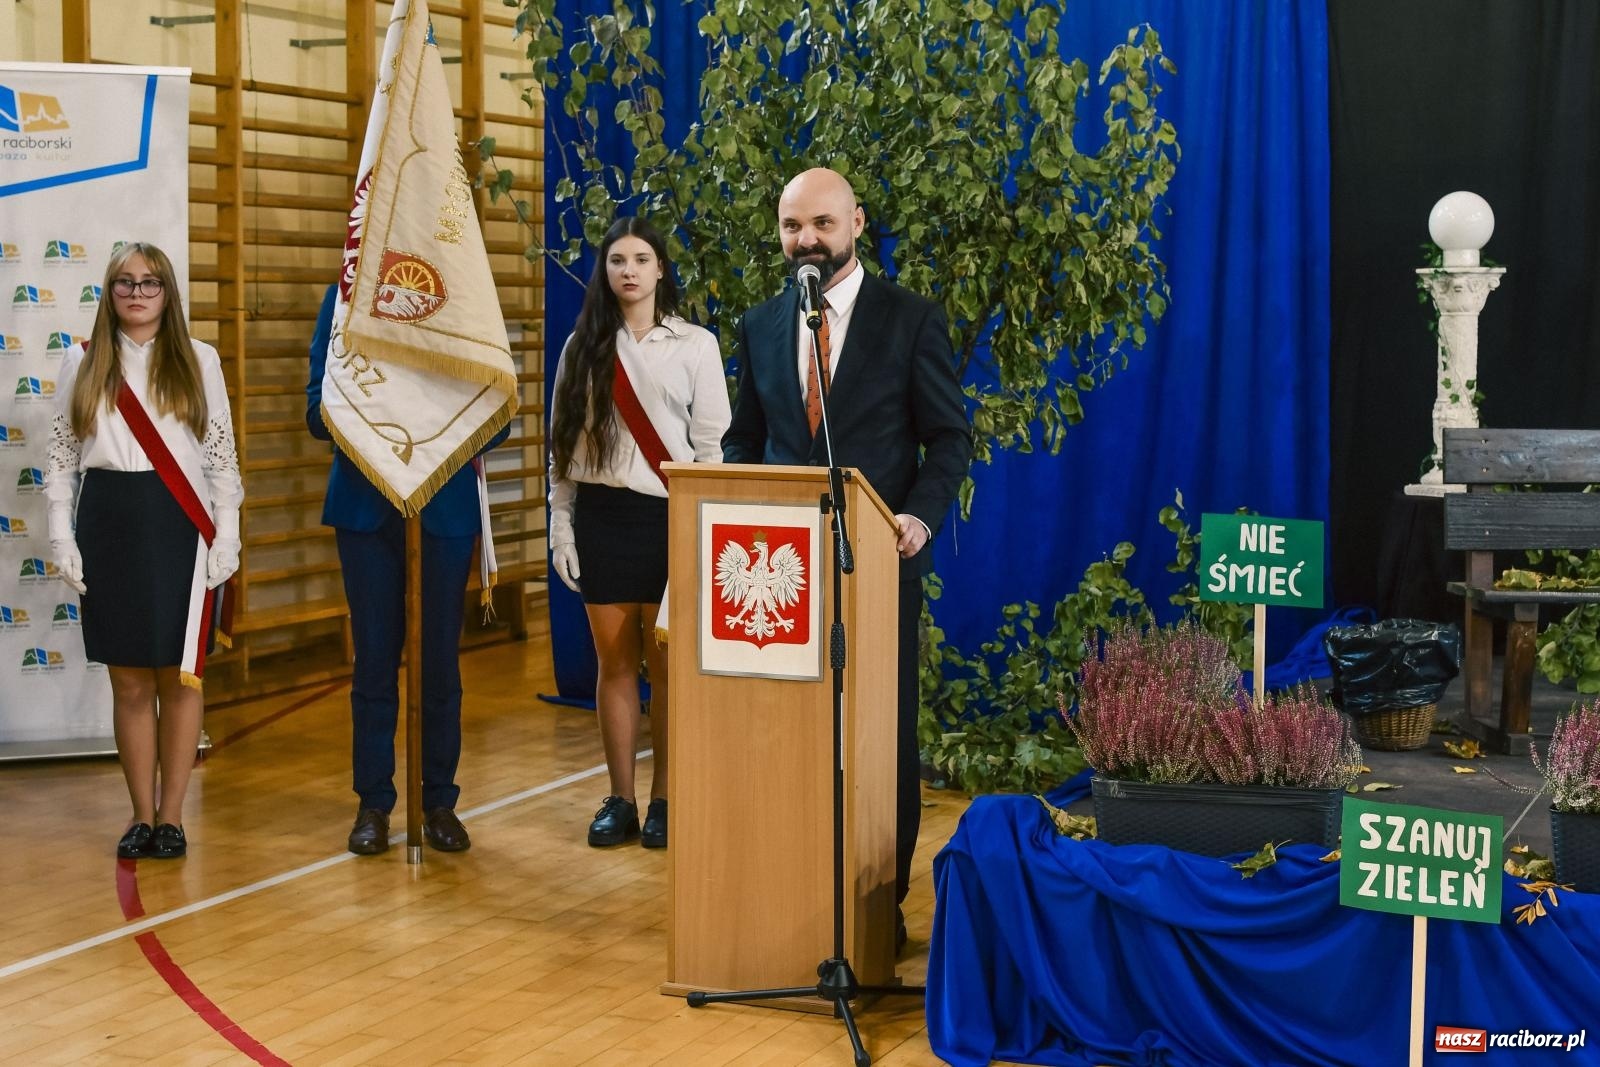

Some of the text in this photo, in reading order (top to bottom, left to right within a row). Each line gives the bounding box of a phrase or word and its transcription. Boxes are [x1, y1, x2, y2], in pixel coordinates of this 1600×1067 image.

[3, 136, 72, 149] raciborski
[1239, 523, 1286, 555] NIE
[1207, 553, 1305, 597] ŚMIEĆ
[1359, 812, 1492, 869] SZANUJ
[1357, 862, 1486, 909] ZIELEŃ
